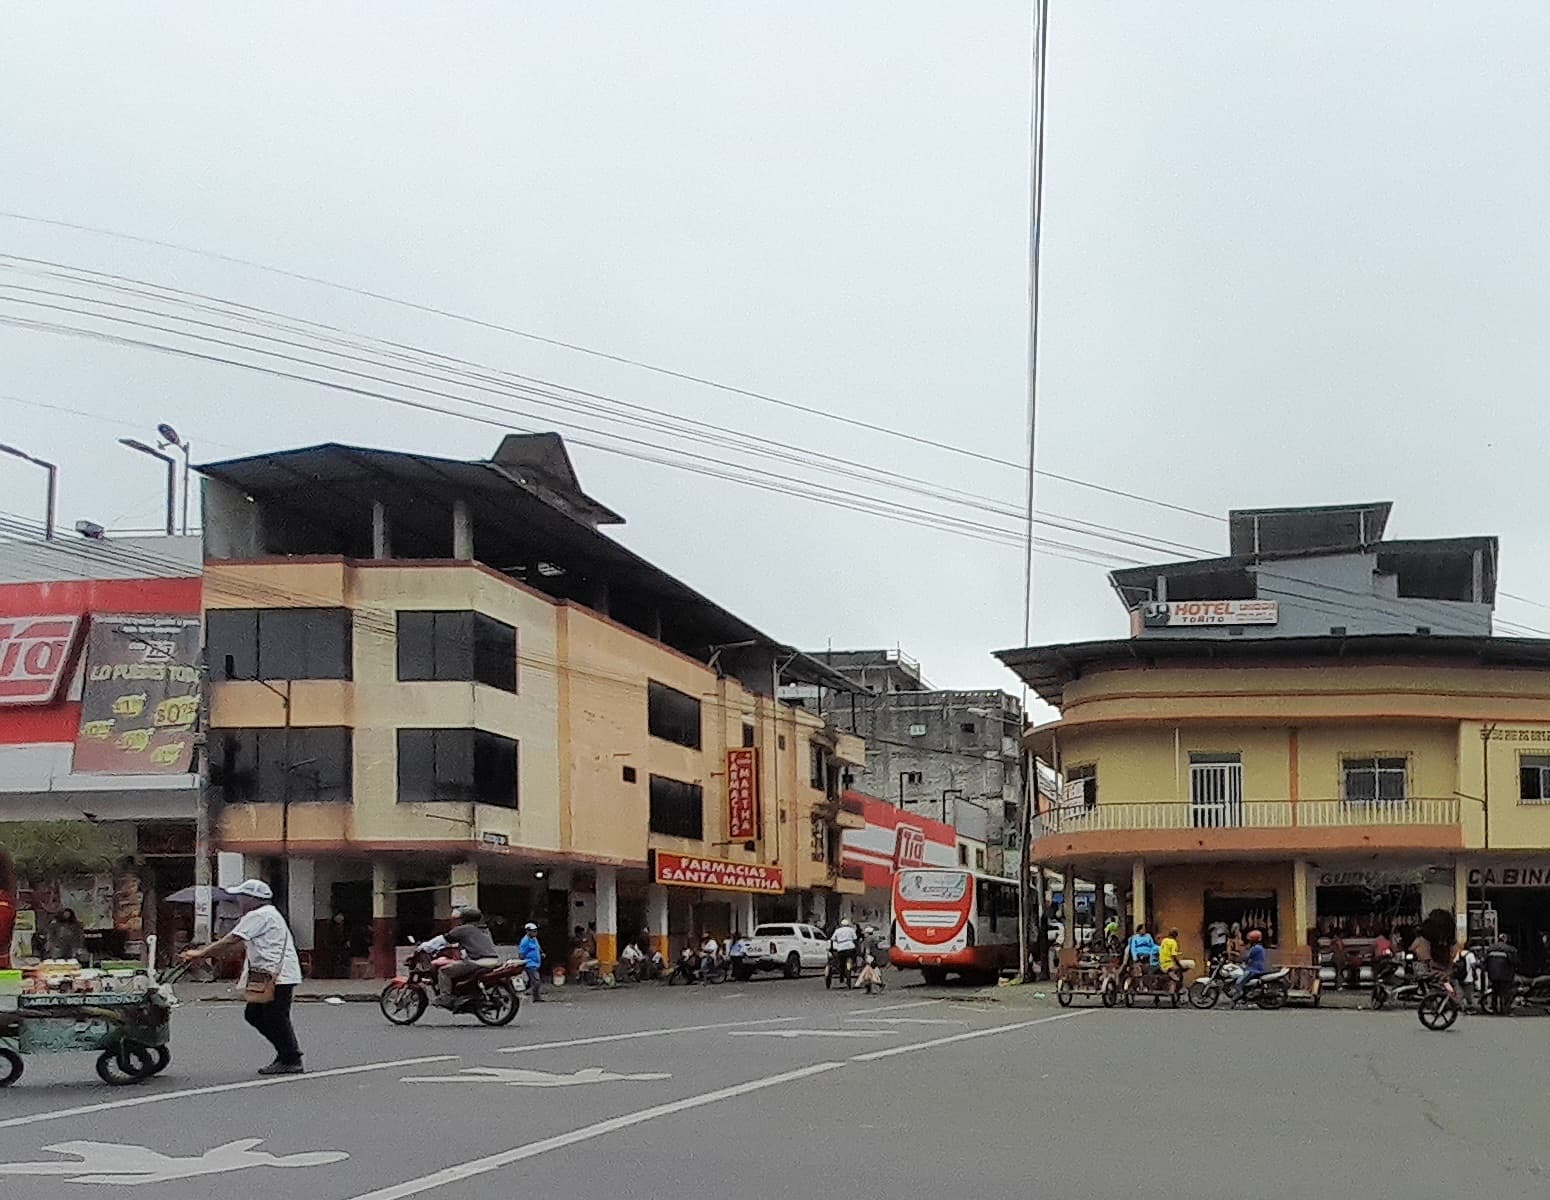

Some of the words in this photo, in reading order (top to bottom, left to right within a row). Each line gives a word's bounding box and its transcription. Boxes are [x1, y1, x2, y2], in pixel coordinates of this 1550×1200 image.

[1174, 603, 1235, 615] HOTEL
[729, 752, 740, 835] FARMACIAS
[740, 767, 751, 830] MARTHA
[680, 857, 767, 878] FARMACIAS
[662, 868, 718, 884] SANTA
[722, 874, 781, 890] MARTHA
